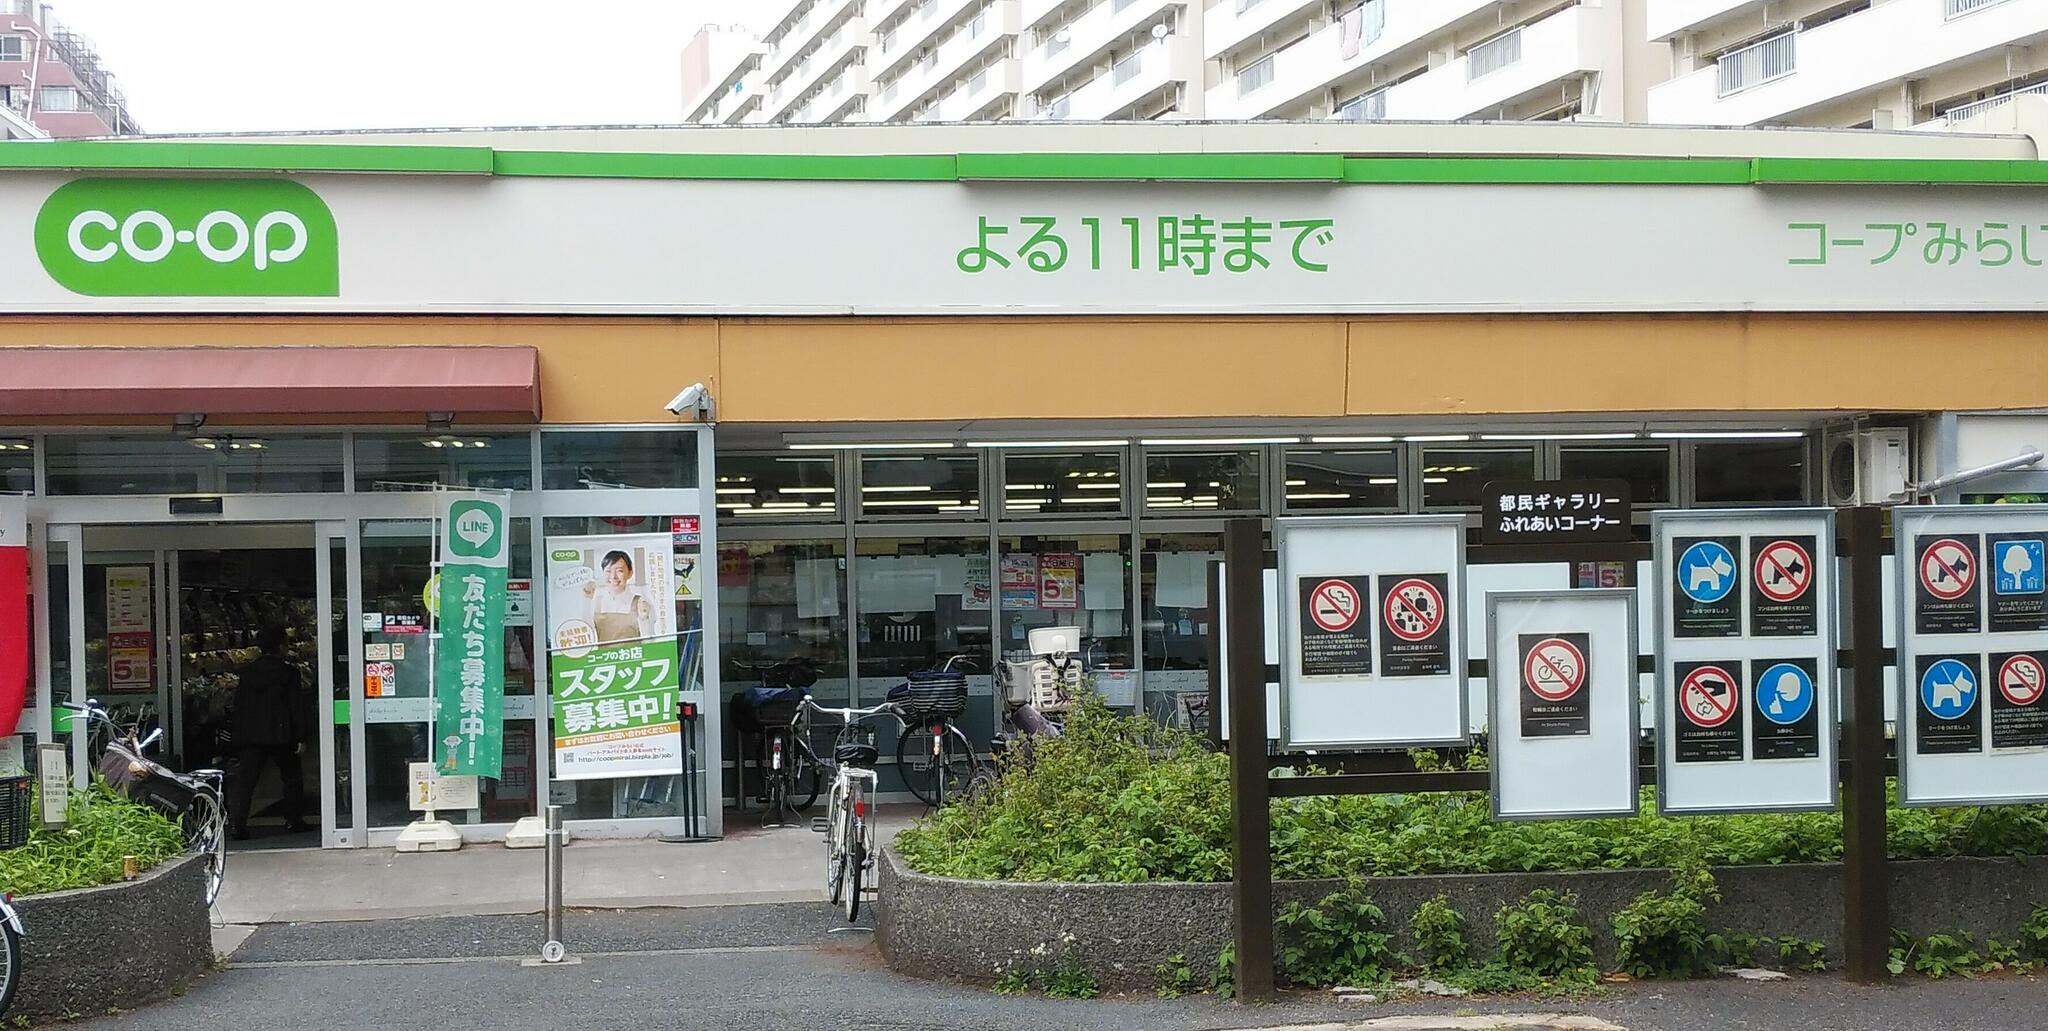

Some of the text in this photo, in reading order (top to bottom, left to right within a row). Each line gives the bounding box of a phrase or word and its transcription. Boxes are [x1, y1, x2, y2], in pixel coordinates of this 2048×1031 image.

[955, 213, 1335, 276] よる11時まで
[1500, 493, 1620, 512] 都民ギャラリー
[463, 521, 489, 533] LINE
[1500, 514, 1620, 532] ふれあいコーナー
[459, 573, 486, 766] 友だち募集中!
[588, 647, 643, 663] コープのお店
[560, 659, 670, 698] スタッフ
[562, 692, 672, 733] 募集中!
